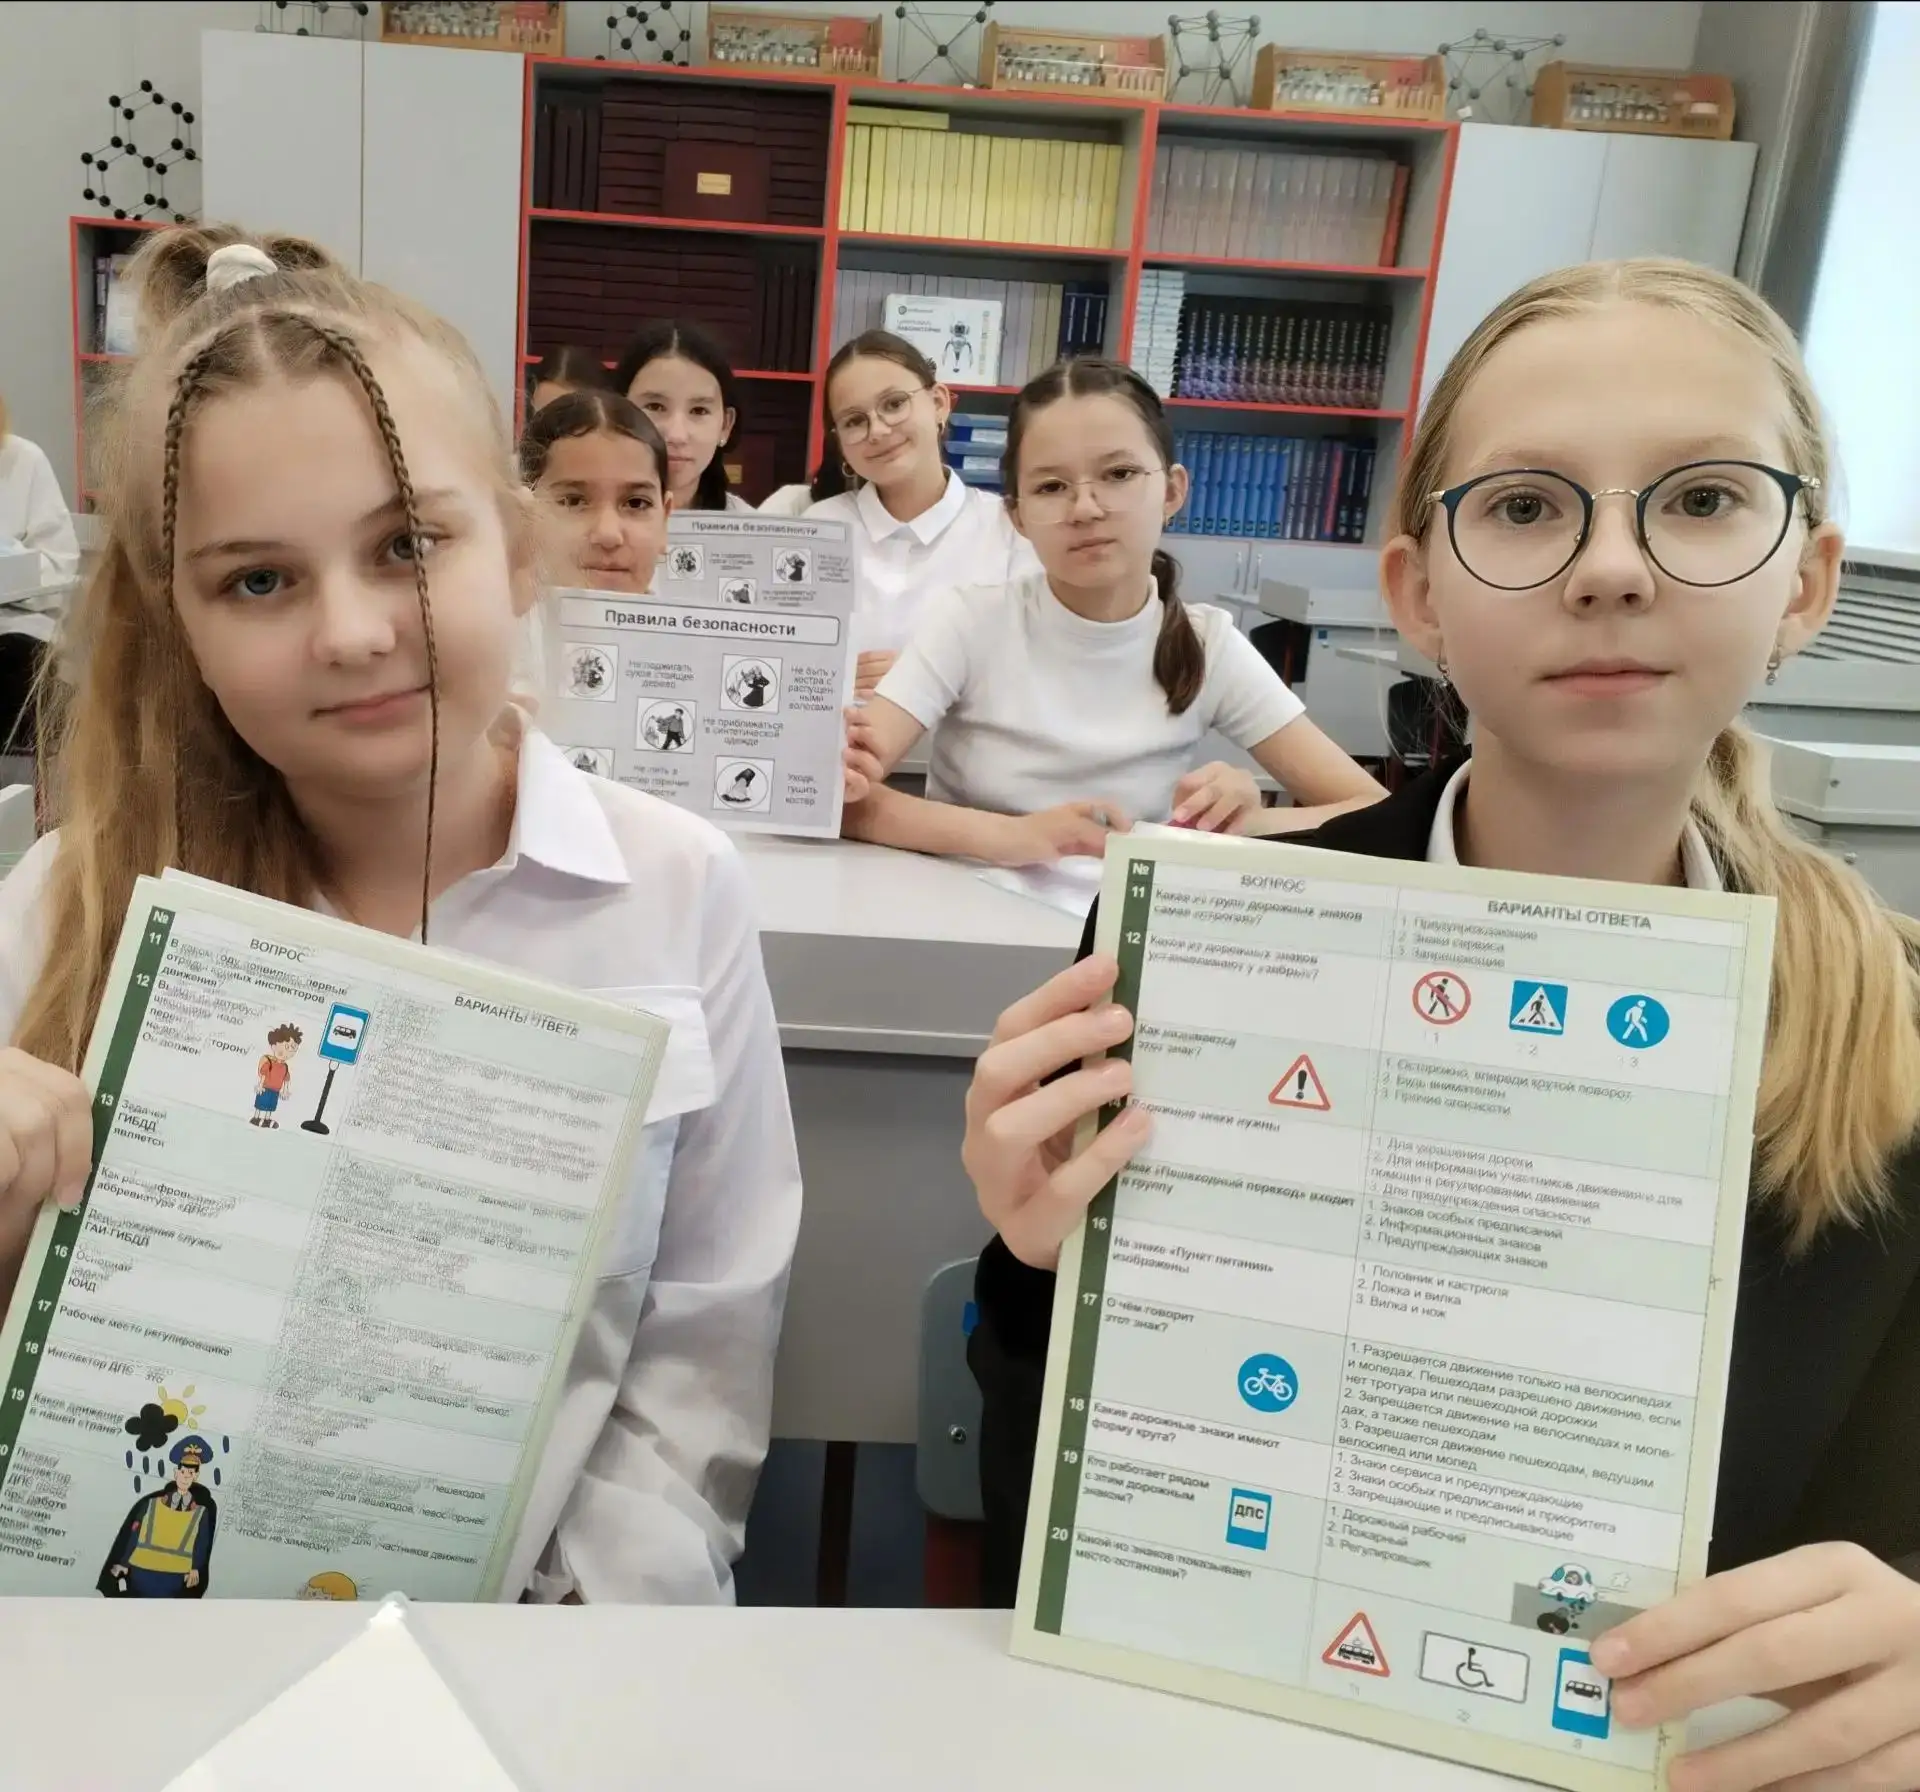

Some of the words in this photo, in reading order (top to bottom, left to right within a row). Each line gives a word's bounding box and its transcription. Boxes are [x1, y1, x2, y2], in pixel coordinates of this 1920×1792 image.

[692, 521, 739, 532] Правила
[605, 610, 677, 628] Правила
[683, 616, 796, 636] безопасности
[1132, 862, 1149, 875] №
[1131, 886, 1145, 897] 11
[1240, 874, 1306, 892] ВОПРОС
[1319, 910, 1362, 922] знаков
[1487, 900, 1581, 922] ВАРИАНТЫ
[1585, 911, 1651, 930] ОТВЕТА
[147, 932, 161, 944] 11
[1125, 931, 1141, 944] 12
[249, 938, 306, 963] ВОПРОС
[134, 974, 150, 986] 12
[453, 996, 528, 1024] ВАРИАНТЫ
[98, 1093, 114, 1106] 13
[116, 1112, 158, 1131] ГИБДД
[1091, 1217, 1107, 1230] 16
[1381, 1201, 1424, 1217] Знаков
[1427, 1210, 1473, 1225] особых
[1477, 1218, 1562, 1240] предписаний
[1113, 1236, 1129, 1248] На
[1379, 1217, 1494, 1246] Информационных
[1498, 1238, 1541, 1252] знаков
[52, 1245, 68, 1257] 16
[1377, 1232, 1500, 1262] Предупреждающих
[1504, 1254, 1547, 1269] знаков
[1371, 1280, 1410, 1296] Ложка
[1413, 1290, 1421, 1298] и
[1424, 1291, 1461, 1305] вилка
[1373, 1265, 1433, 1285] Половник
[1436, 1278, 1444, 1286] и
[1447, 1280, 1508, 1300] кастрюля
[36, 1300, 52, 1312] 17
[1081, 1292, 1096, 1306] 17
[1370, 1296, 1407, 1311] Вилка
[1411, 1305, 1418, 1313] и
[1421, 1307, 1446, 1318] нож
[58, 1305, 106, 1325] Рабочее
[1144, 1307, 1193, 1325] говорит
[23, 1341, 39, 1354] 18
[1351, 1343, 1360, 1353] 1.
[1363, 1345, 1446, 1369] Разрешается
[1449, 1362, 1513, 1381] движение
[1517, 1374, 1561, 1389] только
[1564, 1383, 1580, 1393] на
[1584, 1386, 1671, 1411] велосипедах
[9, 1388, 25, 1401] 19
[1068, 1397, 1084, 1411] 18
[1345, 1375, 1367, 1386] нет
[1370, 1379, 1427, 1399] тротуара
[1430, 1390, 1453, 1402] или
[1457, 1395, 1537, 1419] пешеходной
[1540, 1411, 1597, 1429] дорожки
[1347, 1360, 1355, 1368] и
[1358, 1362, 1415, 1381] мопедах.
[1419, 1371, 1495, 1395] Пешеходам
[1499, 1387, 1572, 1408] разрешено
[1575, 1401, 1645, 1423] движение,
[1649, 1414, 1681, 1428] если
[1091, 1417, 1132, 1437] форму
[1136, 1428, 1175, 1444] круга?
[1093, 1403, 1127, 1418] Какие
[1130, 1412, 1196, 1433] дорожные
[1199, 1426, 1235, 1440] знаки
[1237, 1433, 1279, 1448] имеют
[1341, 1405, 1367, 1418] дах,
[1371, 1411, 1378, 1419] а
[1382, 1413, 1418, 1427] также
[1422, 1420, 1496, 1443] пешеходам
[1343, 1388, 1354, 1399] 2.
[1357, 1391, 1442, 1417] Запрещается
[1445, 1409, 1509, 1429] движение
[1513, 1422, 1529, 1432] на
[1532, 1425, 1619, 1450] велосипедах
[1624, 1442, 1632, 1451] и
[1635, 1444, 1674, 1459] мопе-
[1062, 1450, 1077, 1463] 19
[1338, 1436, 1405, 1458] велосипед
[1409, 1450, 1432, 1461] или
[1435, 1455, 1477, 1471] мопед
[1340, 1419, 1351, 1430] 3.
[1354, 1421, 1438, 1447] Разрешается
[1441, 1440, 1505, 1460] движение
[1509, 1453, 1588, 1477] пешеходам,
[1591, 1469, 1654, 1490] ведущим
[1108, 1460, 1166, 1481] работает
[1168, 1474, 1209, 1492] рядом
[1337, 1453, 1347, 1463] 1.
[1350, 1455, 1386, 1471] Знаки
[1389, 1465, 1441, 1483] сервиса
[1445, 1476, 1453, 1484] и
[1456, 1478, 1583, 1511] предупреждающие
[1126, 1481, 1194, 1502] дорожным
[1334, 1468, 1345, 1479] 2.
[1348, 1471, 1385, 1487] Знаки
[1388, 1481, 1435, 1497] особых
[1439, 1491, 1524, 1515] предписаний
[1528, 1508, 1536, 1517] и
[1539, 1510, 1616, 1533] приоритета
[1234, 1504, 1264, 1522] ДПС
[1332, 1483, 1343, 1494] 3.
[1347, 1486, 1440, 1515] Запрещающие
[1444, 1508, 1452, 1516] и
[1455, 1510, 1574, 1542] предписывающие
[1052, 1527, 1068, 1541] 20
[1330, 1507, 1340, 1518] 1.
[1342, 1509, 1409, 1533] Дорожный
[1412, 1523, 1466, 1544] рабочий
[1342, 1524, 1408, 1549] Пожарный
[37, 1551, 76, 1567] цвета?
